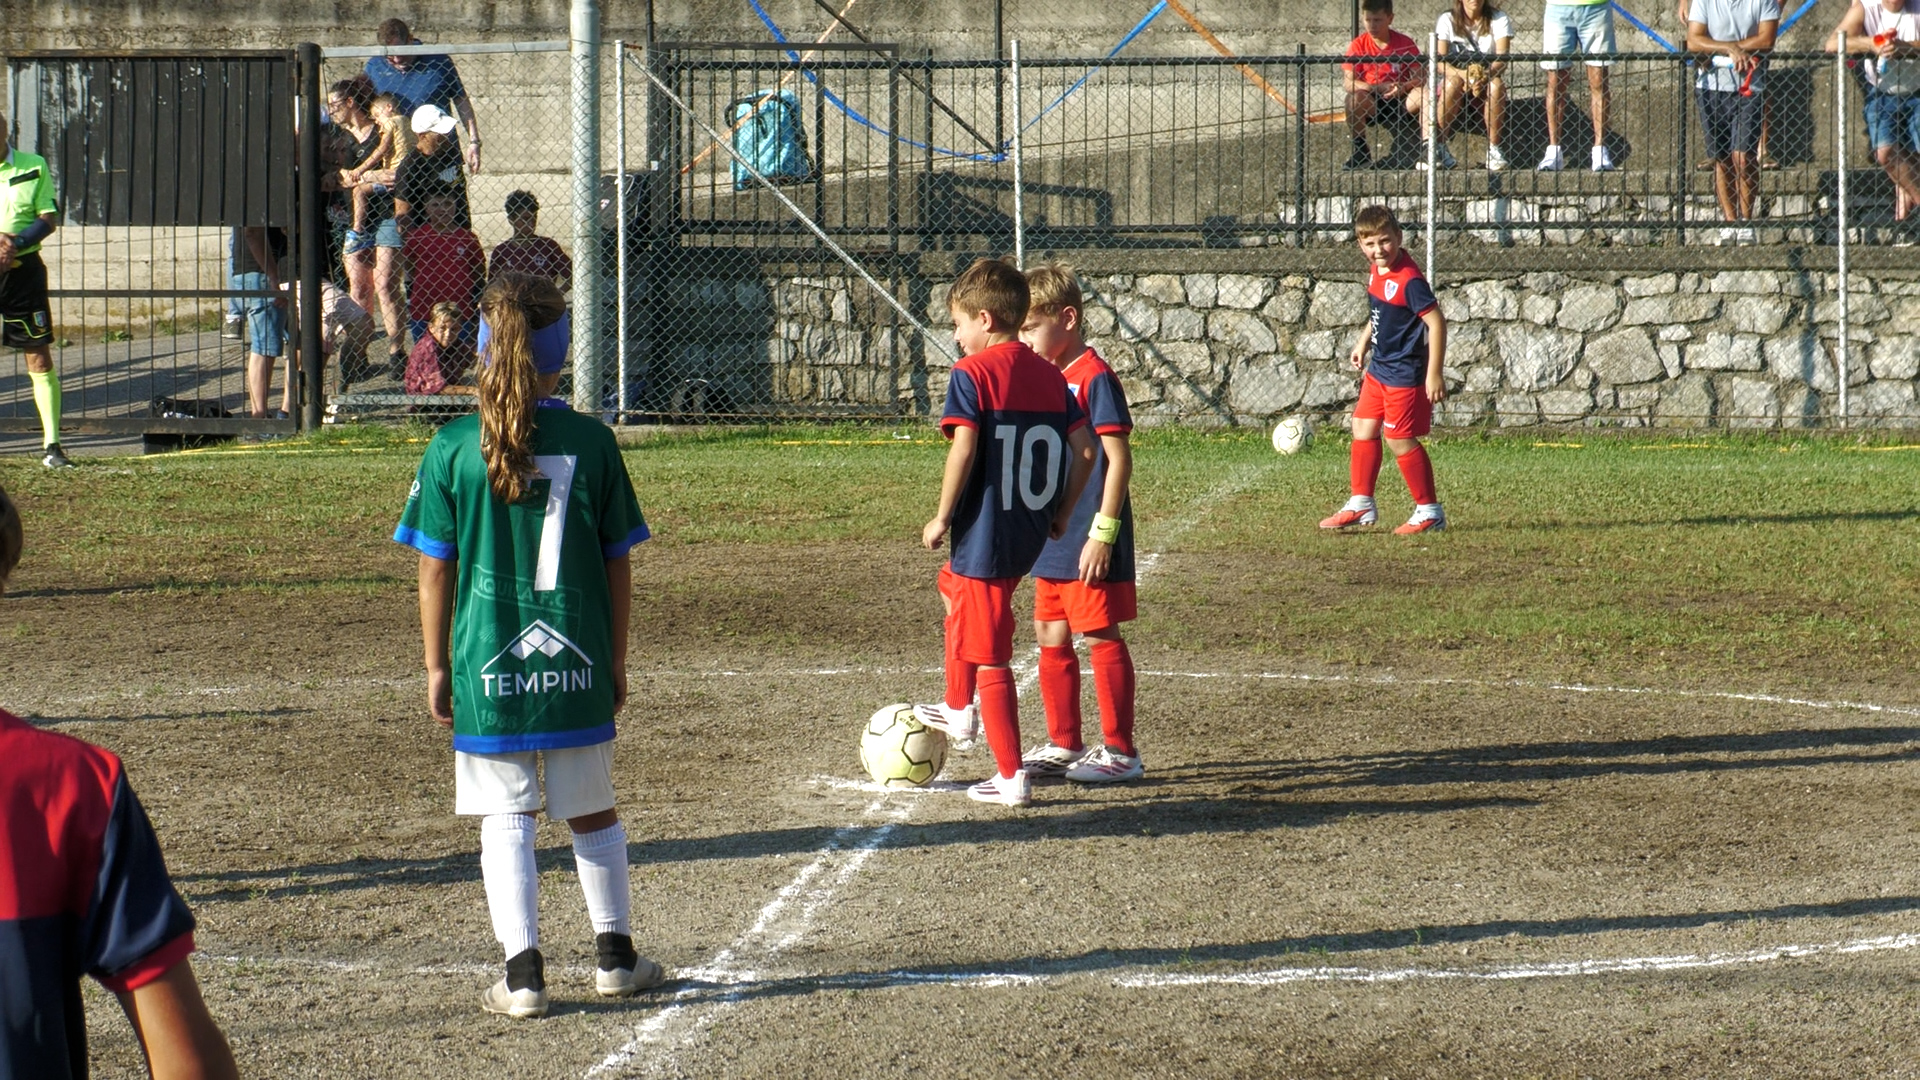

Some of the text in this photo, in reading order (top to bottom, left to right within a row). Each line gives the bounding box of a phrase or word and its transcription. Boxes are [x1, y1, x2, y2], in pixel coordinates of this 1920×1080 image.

[995, 424, 1062, 511] 10
[524, 455, 577, 591] 7
[480, 667, 593, 697] TEMPINI
